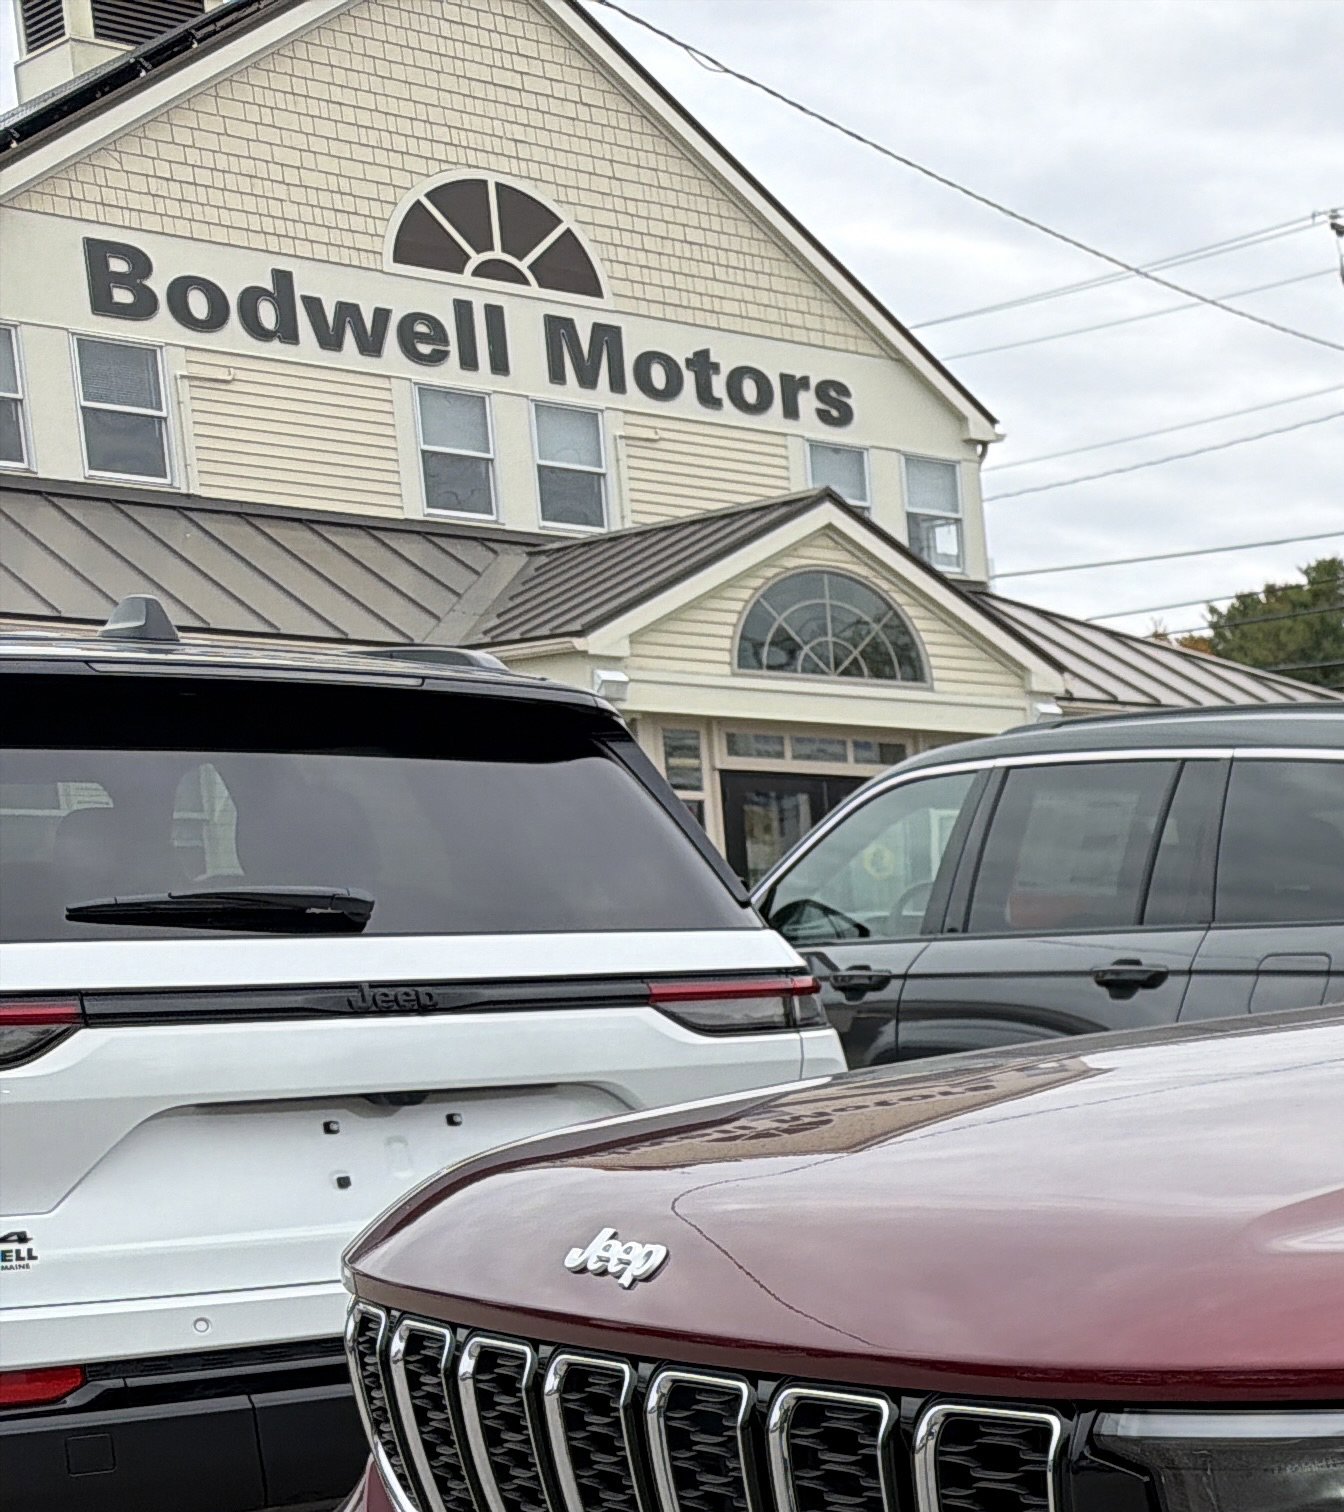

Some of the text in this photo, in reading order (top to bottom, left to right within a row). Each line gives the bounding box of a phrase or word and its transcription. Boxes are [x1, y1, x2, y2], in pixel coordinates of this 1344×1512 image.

[82, 236, 856, 428] Bodwell Motors
[347, 982, 440, 1013] Jeep
[564, 1227, 669, 1290] Jeep
